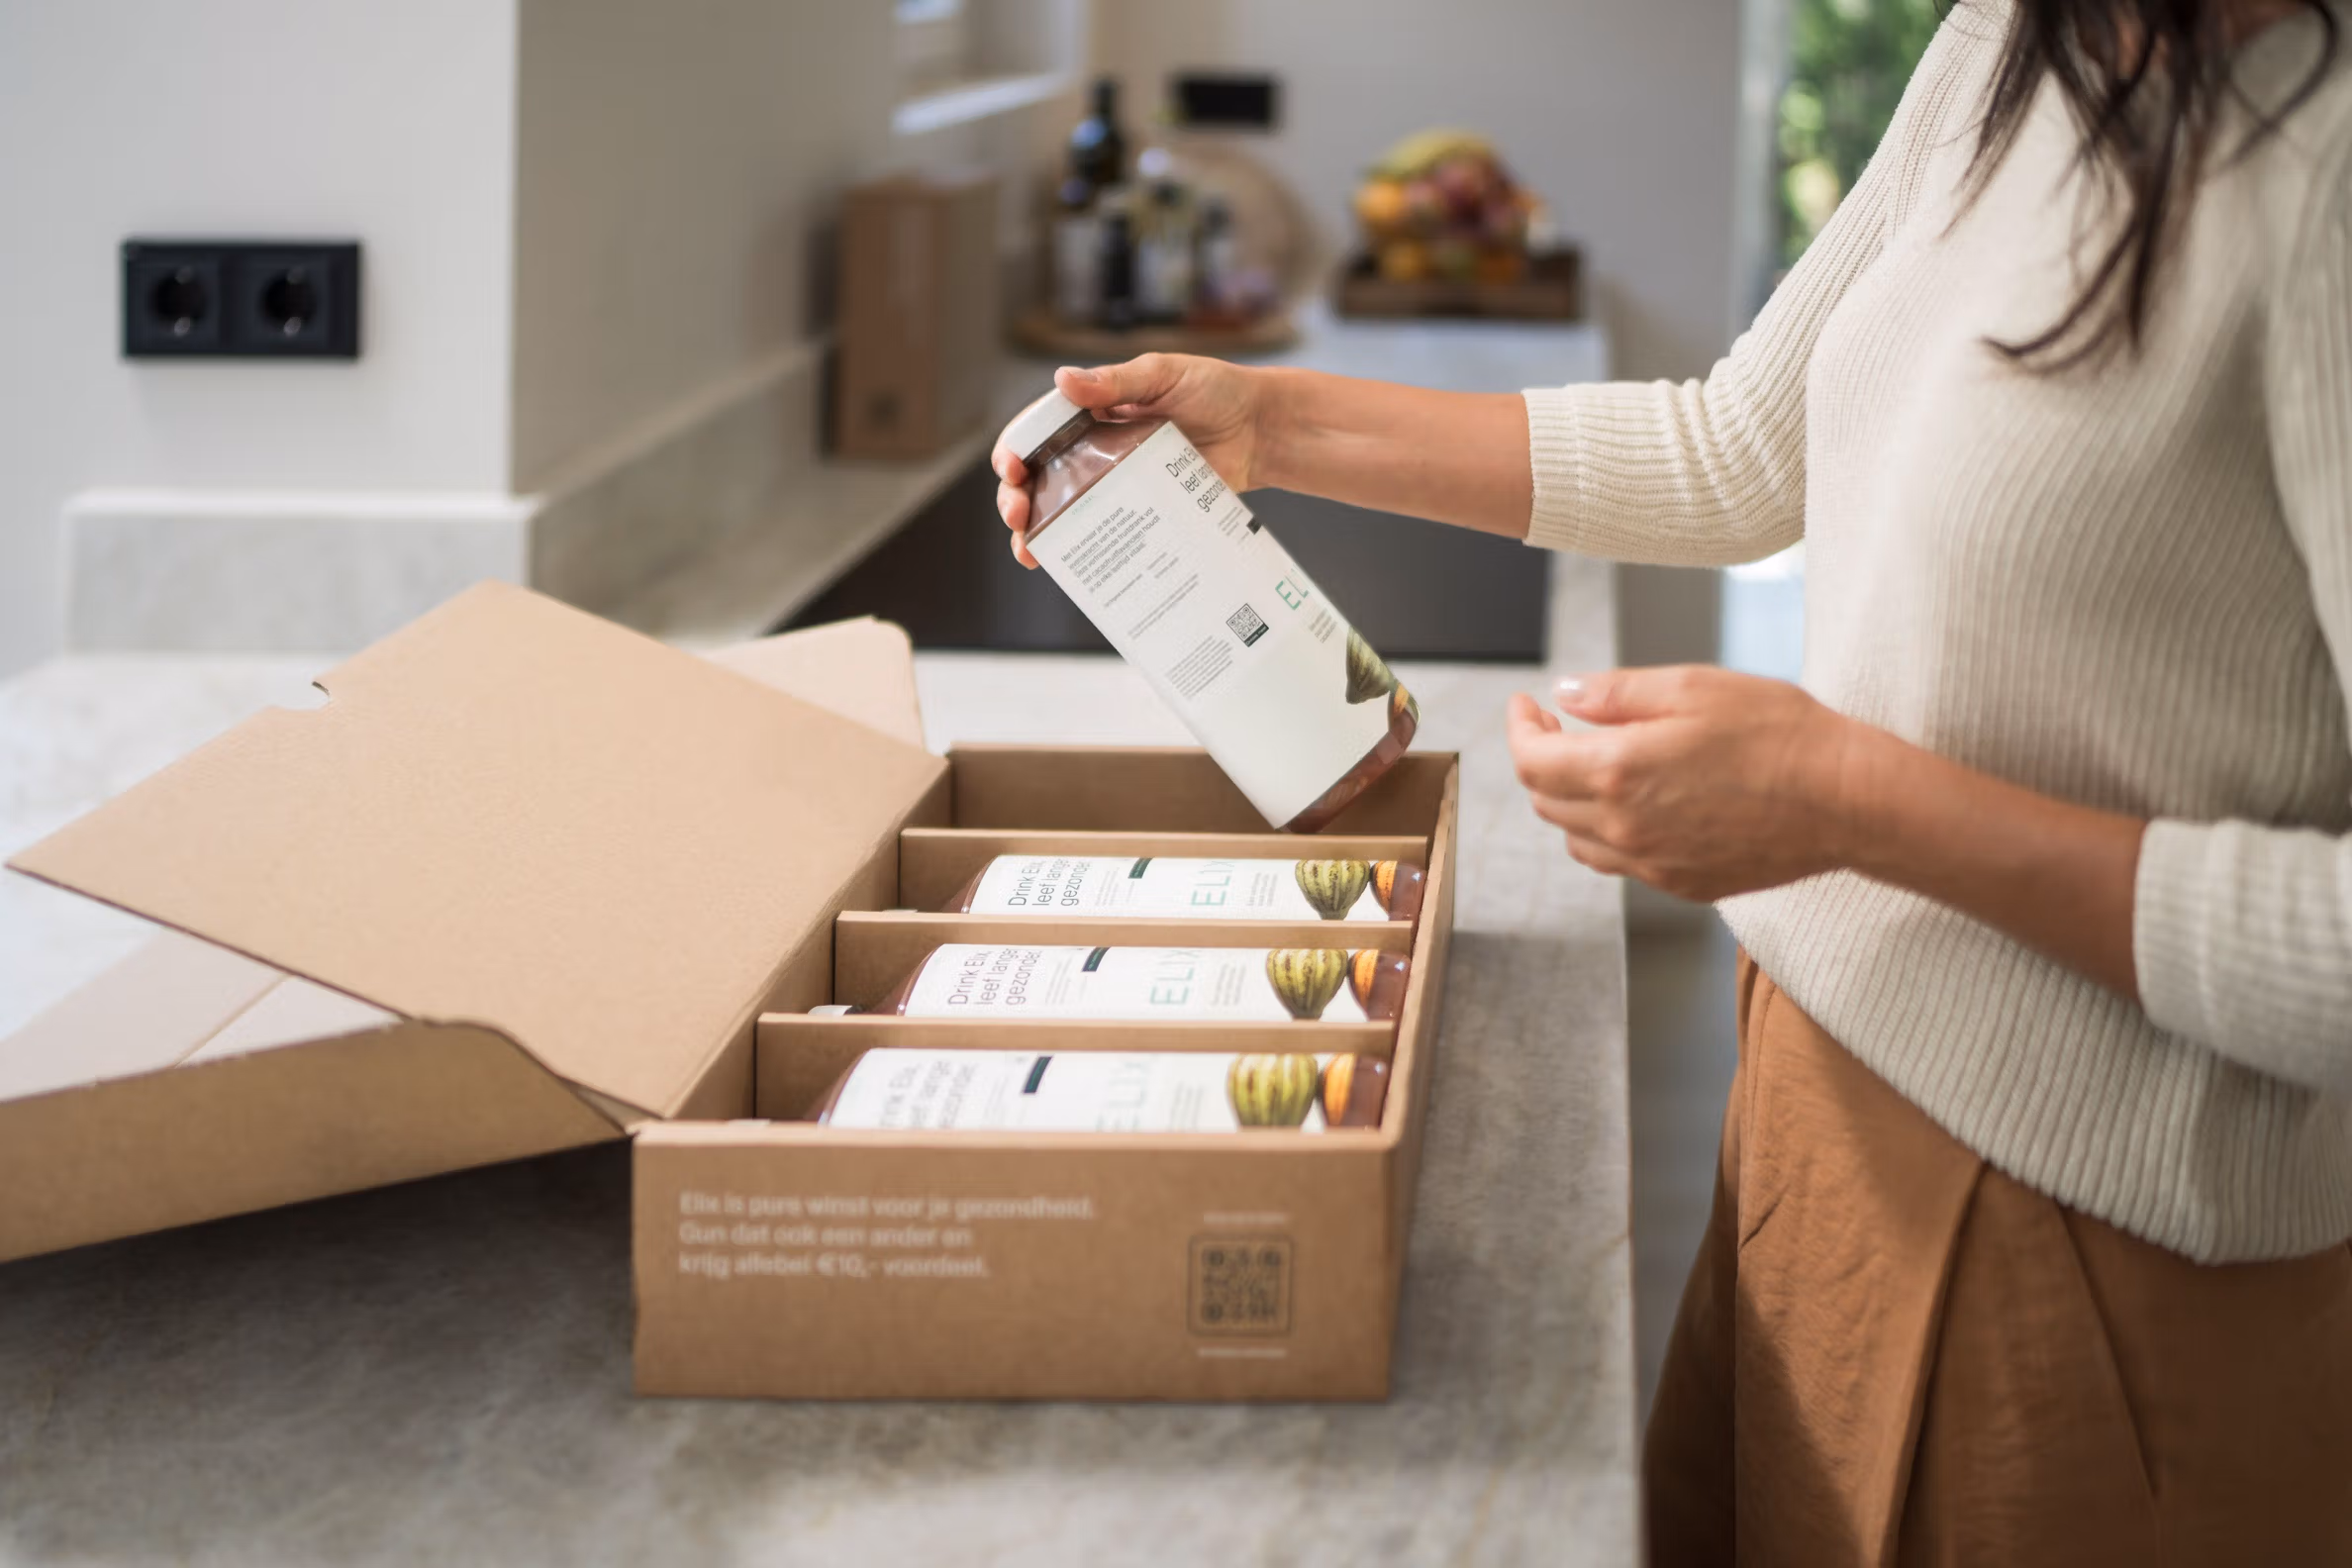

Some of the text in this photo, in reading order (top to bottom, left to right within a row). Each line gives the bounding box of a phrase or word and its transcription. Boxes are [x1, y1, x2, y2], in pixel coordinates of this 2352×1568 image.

[1164, 452, 1192, 478] Drink
[1179, 470, 1201, 494] leef
[1060, 551, 1072, 562] Met
[1094, 524, 1104, 534] je
[1101, 517, 1111, 527] de
[1108, 506, 1126, 522] pure
[1098, 532, 1110, 543] van
[1108, 525, 1118, 535] de
[1115, 508, 1136, 528] natuur.
[1116, 514, 1145, 540] fruitdrank
[1142, 506, 1154, 518] vol
[1140, 514, 1161, 533] houdt
[1008, 876, 1035, 906] Drink
[1031, 883, 1056, 906] leef
[1191, 859, 1234, 907] ELIX
[947, 969, 980, 1005] Drink
[973, 948, 1019, 1005] leef langer
[1149, 949, 1202, 1006] ELIX
[724, 1194, 743, 1215] is
[749, 1197, 802, 1219] pure
[806, 1195, 869, 1217] winst
[872, 1198, 923, 1218] voor
[928, 1196, 949, 1222] je
[680, 1220, 974, 1247] Gun dat ook een ander en
[679, 1250, 730, 1279] krijg
